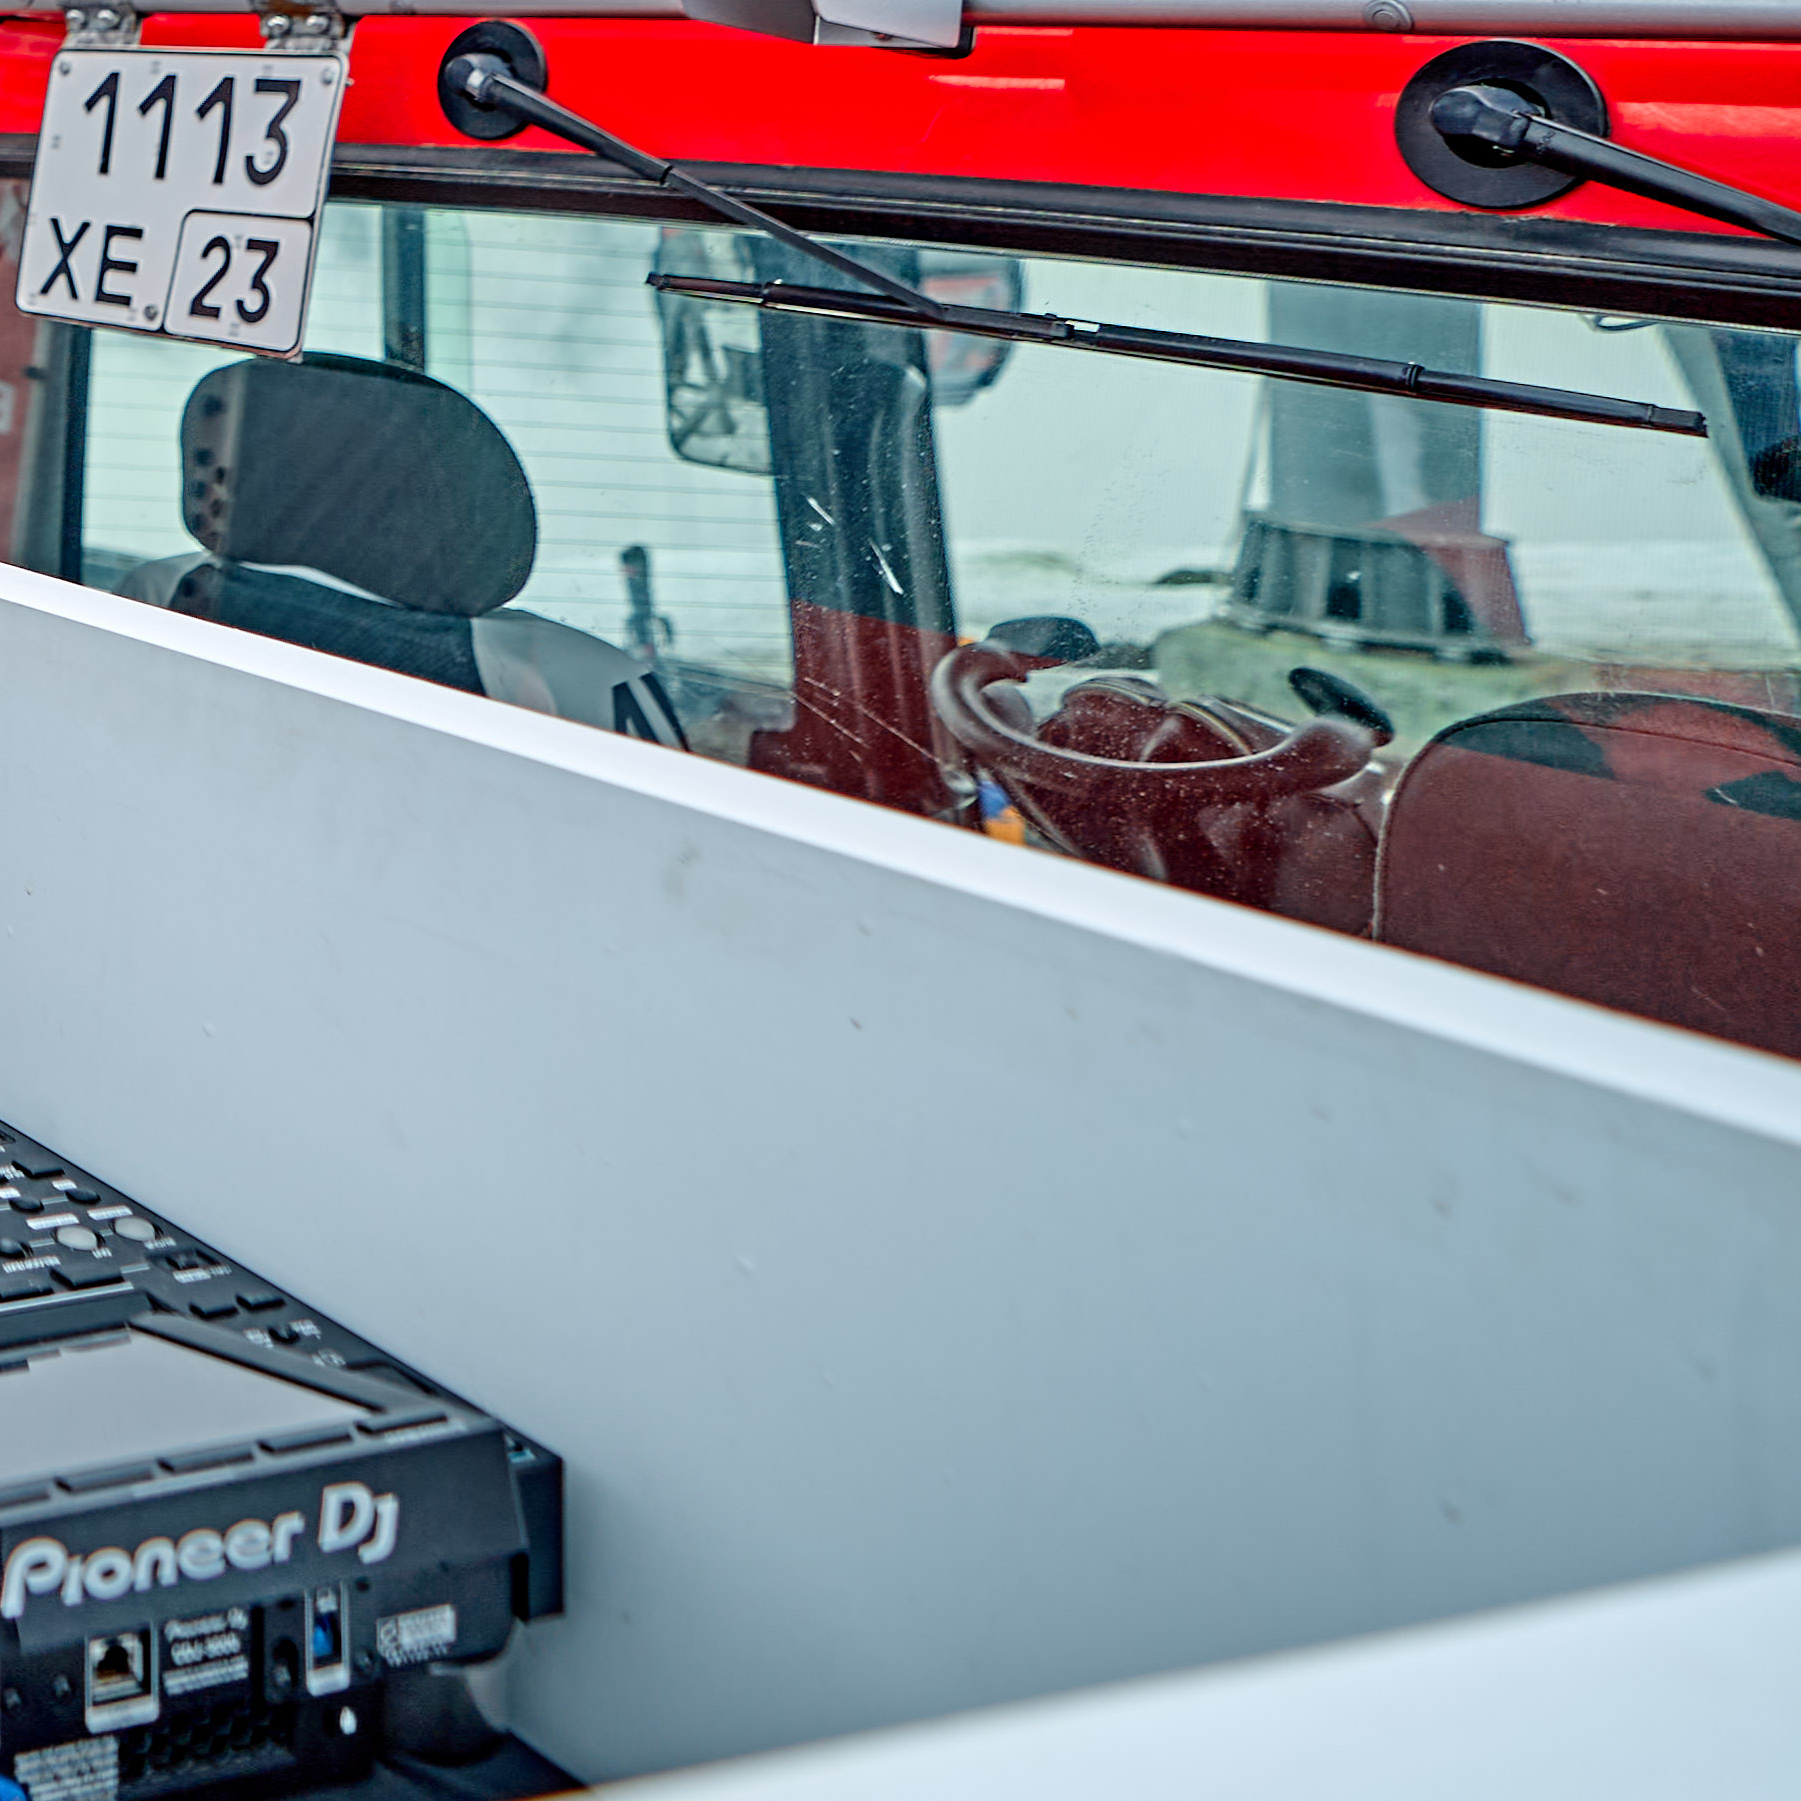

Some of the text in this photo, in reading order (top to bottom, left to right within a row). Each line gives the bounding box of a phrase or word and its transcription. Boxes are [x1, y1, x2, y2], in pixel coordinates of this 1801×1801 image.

[84, 71, 302, 187] 1113
[189, 235, 280, 324] 23
[0, 1511, 305, 1619] Pioneer
